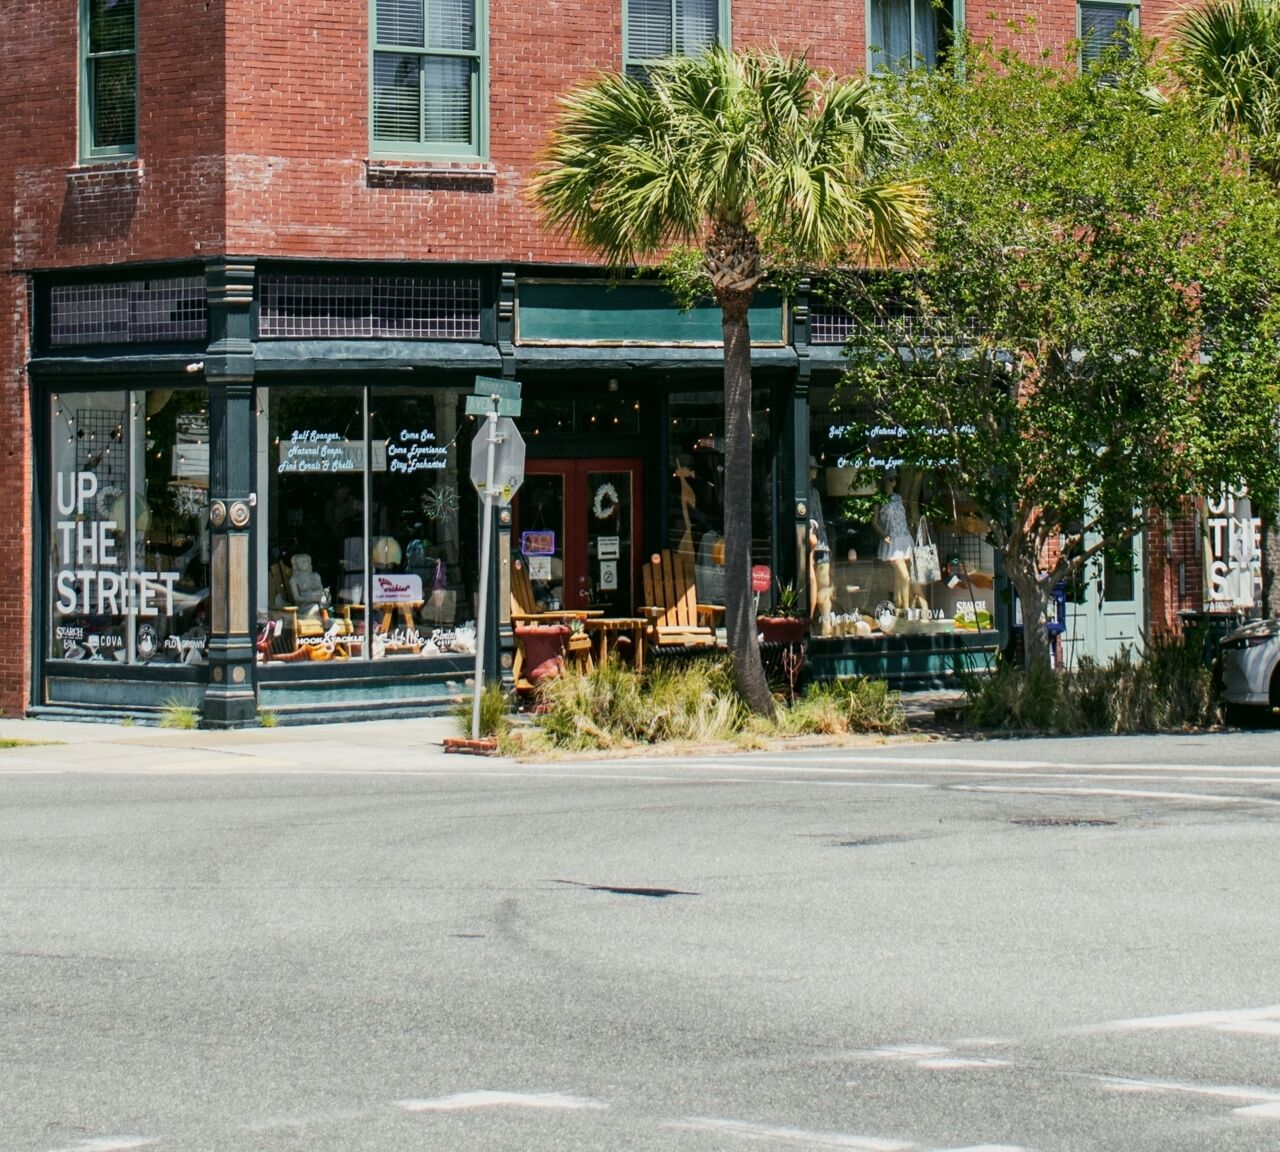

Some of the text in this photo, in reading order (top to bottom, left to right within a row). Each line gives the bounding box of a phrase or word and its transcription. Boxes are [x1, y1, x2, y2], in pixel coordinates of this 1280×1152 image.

[291, 429, 311, 444] Gulf
[400, 429, 419, 441] Come
[288, 445, 320, 458] Natural
[388, 444, 407, 456] Come
[390, 458, 447, 473] Stay Enchanted
[56, 471, 98, 516] UP
[56, 521, 118, 565] THE
[1207, 517, 1262, 559] THE
[56, 570, 180, 617] STREET
[100, 635, 122, 647] COVA
[297, 637, 324, 645] HOOK
